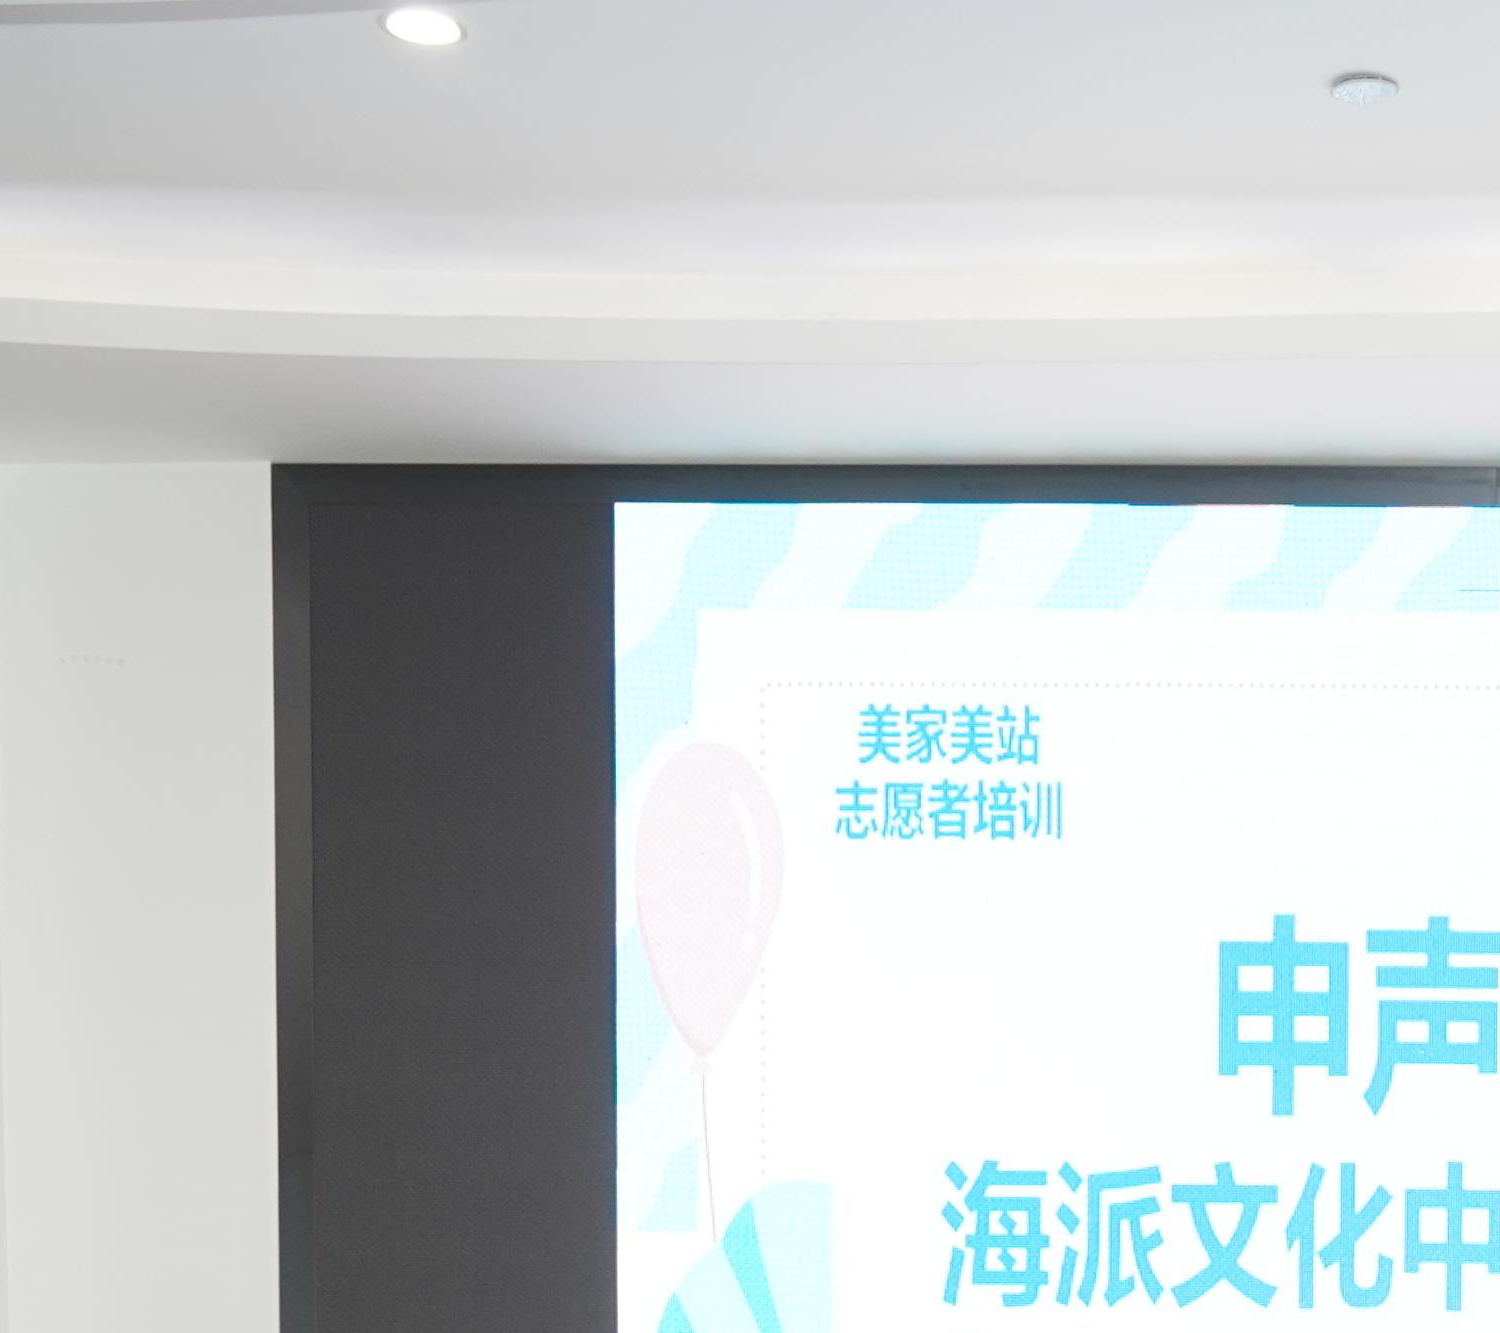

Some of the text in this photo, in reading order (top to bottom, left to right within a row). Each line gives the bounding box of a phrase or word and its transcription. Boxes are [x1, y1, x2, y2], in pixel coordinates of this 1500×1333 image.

[857, 703, 1041, 765] 美家美站
[834, 779, 1063, 841] 志愿者培训
